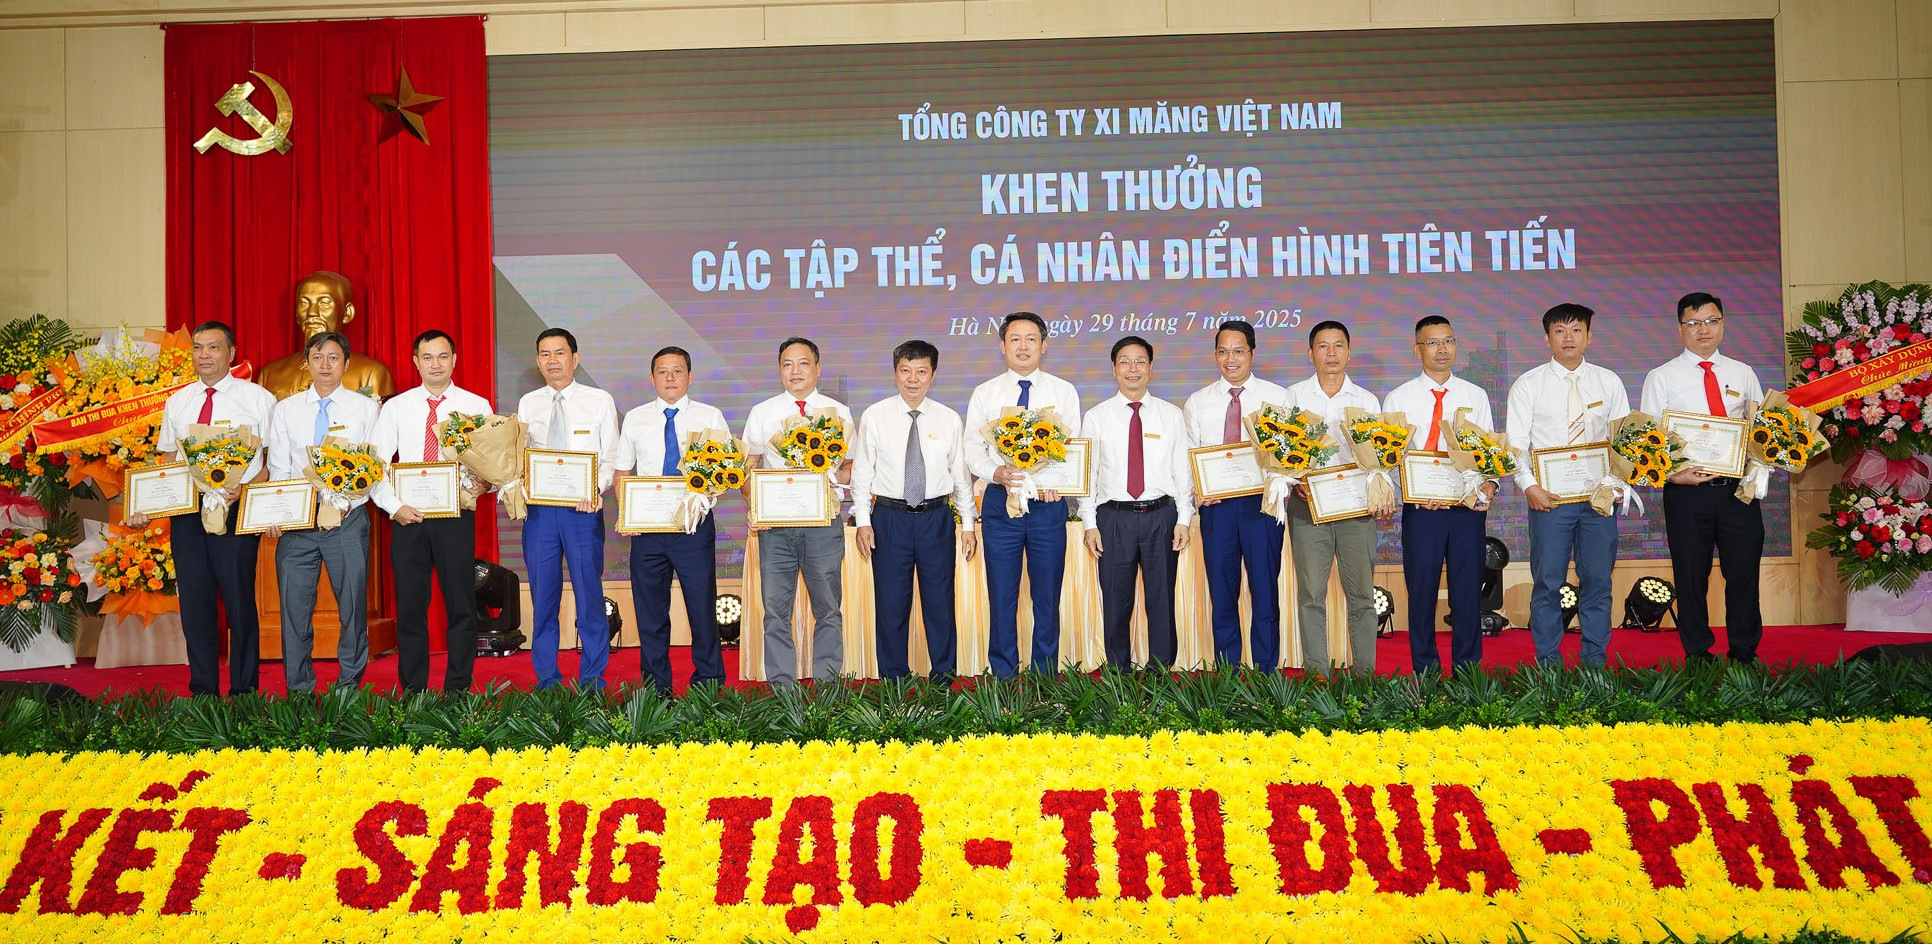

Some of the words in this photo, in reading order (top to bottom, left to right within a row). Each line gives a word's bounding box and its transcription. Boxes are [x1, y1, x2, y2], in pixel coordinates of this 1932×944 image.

[898, 102, 967, 140] TỔNG
[975, 105, 1047, 139] CÔNG
[1056, 109, 1085, 136] TY
[1094, 108, 1120, 135] XI
[1129, 100, 1208, 134] MĂNG
[1216, 98, 1272, 137] VIỆT
[1280, 102, 1342, 130] NAM
[981, 171, 1088, 214] KHEN
[1101, 154, 1262, 212] THƯỞNG
[691, 241, 771, 292] CÁC
[784, 238, 859, 298] TẬP
[871, 227, 957, 291] THỂ,
[970, 234, 1025, 285] CÁ
[1037, 231, 1150, 283] NHÂN
[1163, 220, 1258, 279] ĐIỂN
[1272, 226, 1369, 277] HÌNH
[1382, 223, 1472, 273] TIÊN
[1485, 215, 1576, 271] TIẾN
[949, 317, 980, 336] Hà
[1089, 313, 1114, 333] 29
[1120, 313, 1179, 336] tháng
[1185, 312, 1197, 330] 7
[1253, 309, 1302, 329] 2025
[1849, 365, 1867, 378] BỘ
[1868, 354, 1895, 371] XÂY
[1861, 369, 1892, 385] Chúc
[9, 401, 44, 427] CHÍNH
[70, 416, 87, 428] BAN
[88, 413, 100, 423] THI
[101, 408, 117, 419] ĐUA
[117, 401, 139, 414] KHEN
[0, 770, 252, 916] KẾT
[336, 777, 666, 915] SÁNG
[706, 791, 924, 934] TẠO
[1041, 788, 1237, 900] THI
[1609, 754, 1932, 891] PHÁT
